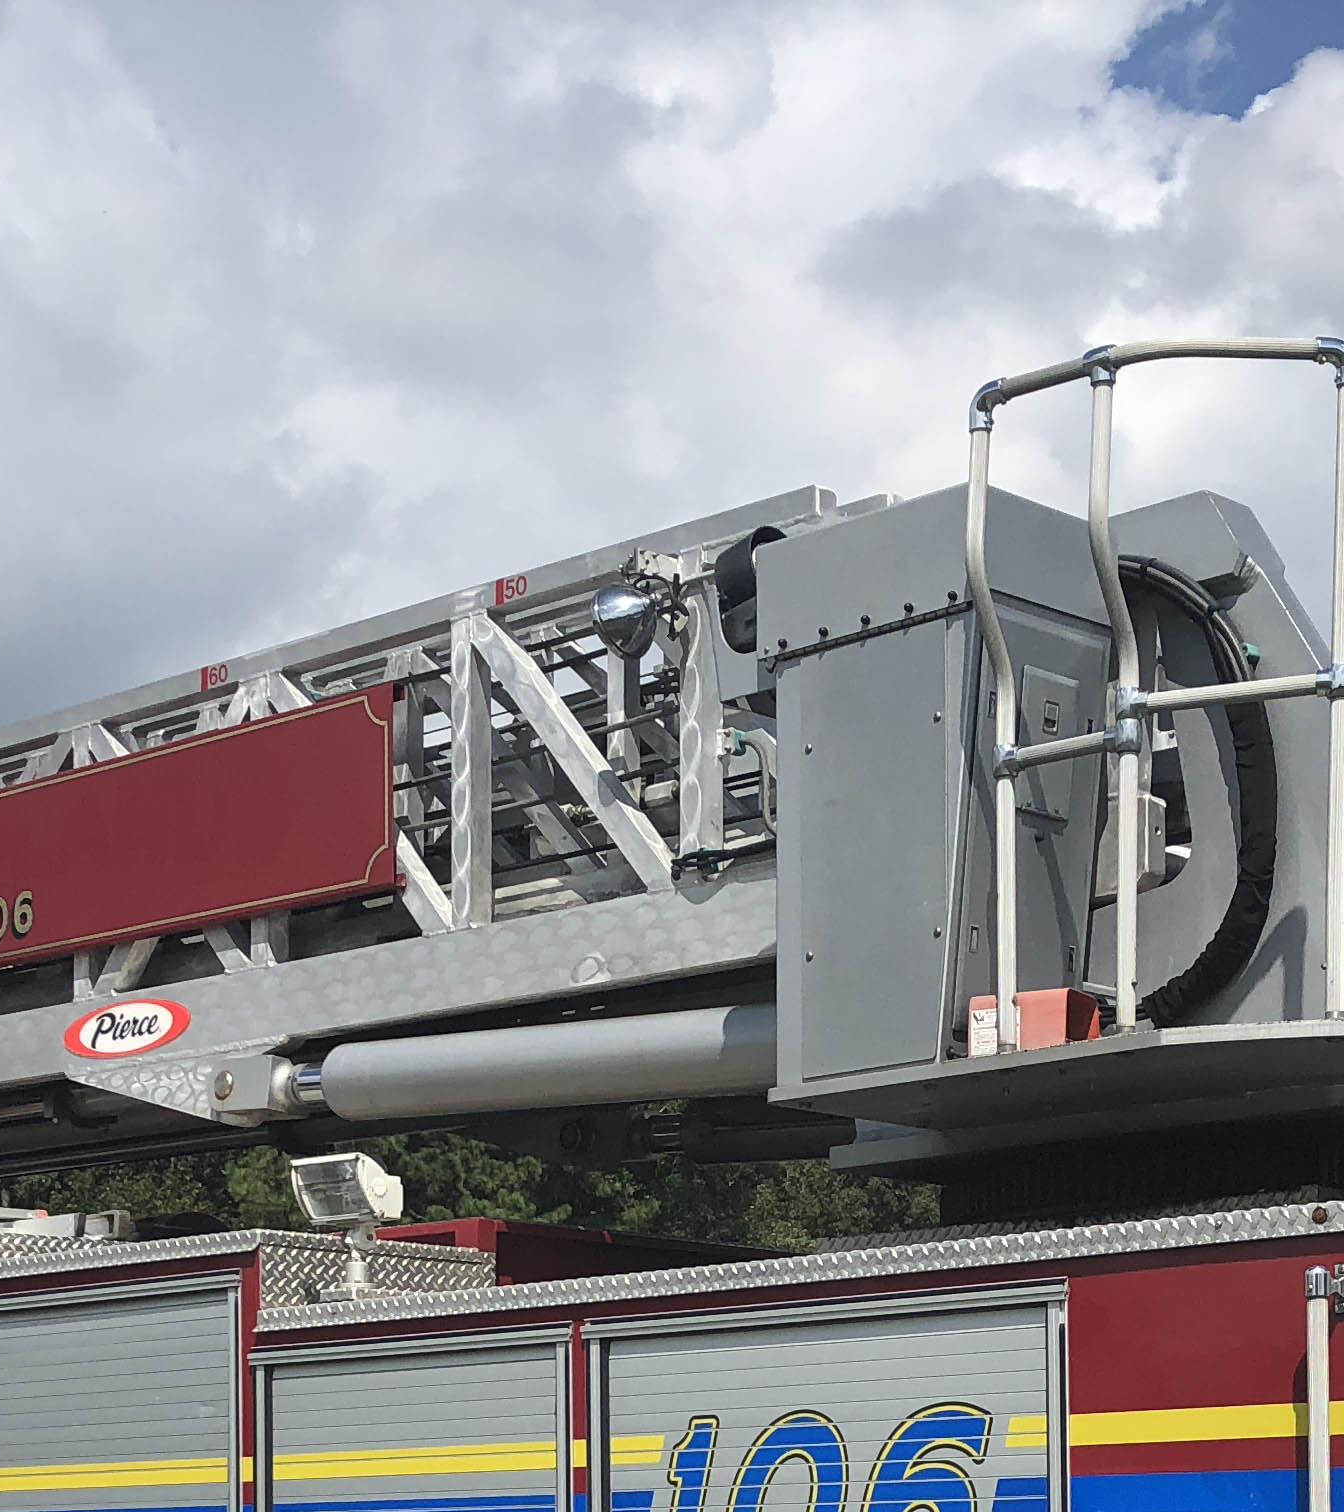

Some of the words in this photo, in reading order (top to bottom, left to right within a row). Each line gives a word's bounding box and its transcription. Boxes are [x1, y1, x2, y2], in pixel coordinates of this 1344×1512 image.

[505, 576, 527, 600] 50
[209, 664, 228, 686] 60
[91, 1012, 160, 1049] Pierce
